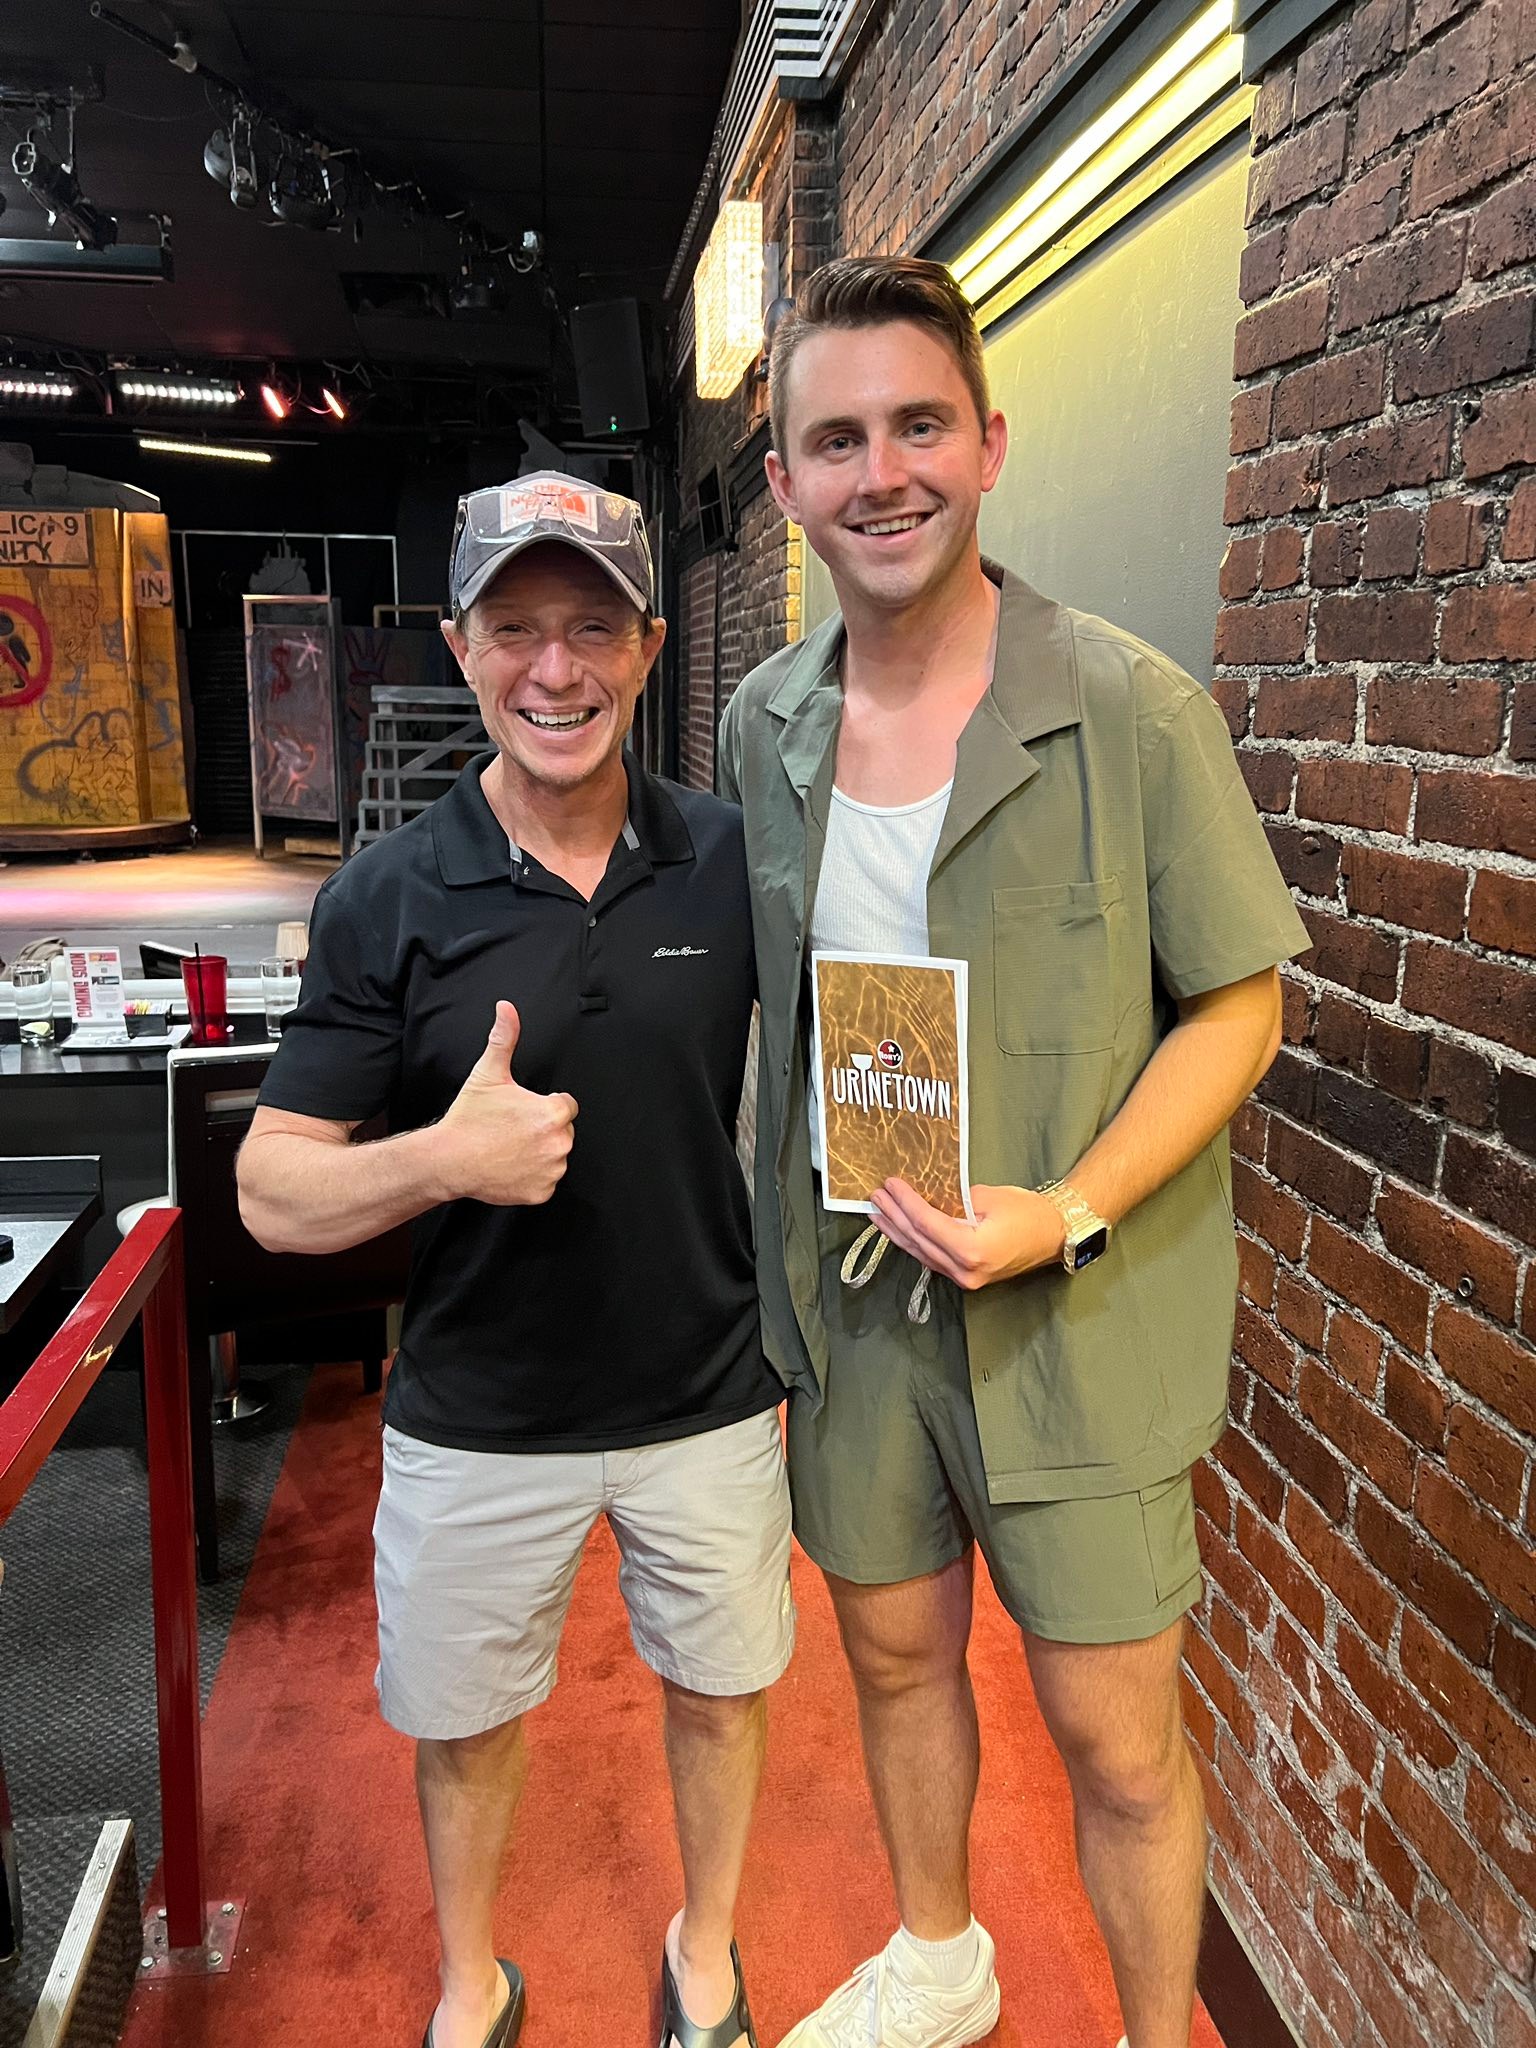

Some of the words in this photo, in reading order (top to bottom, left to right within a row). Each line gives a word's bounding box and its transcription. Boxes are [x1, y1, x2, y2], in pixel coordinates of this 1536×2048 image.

[140, 578, 164, 598] IN
[70, 953, 88, 977] SOON
[73, 981, 92, 1017] COMING
[832, 1053, 951, 1121] URINETOWN
